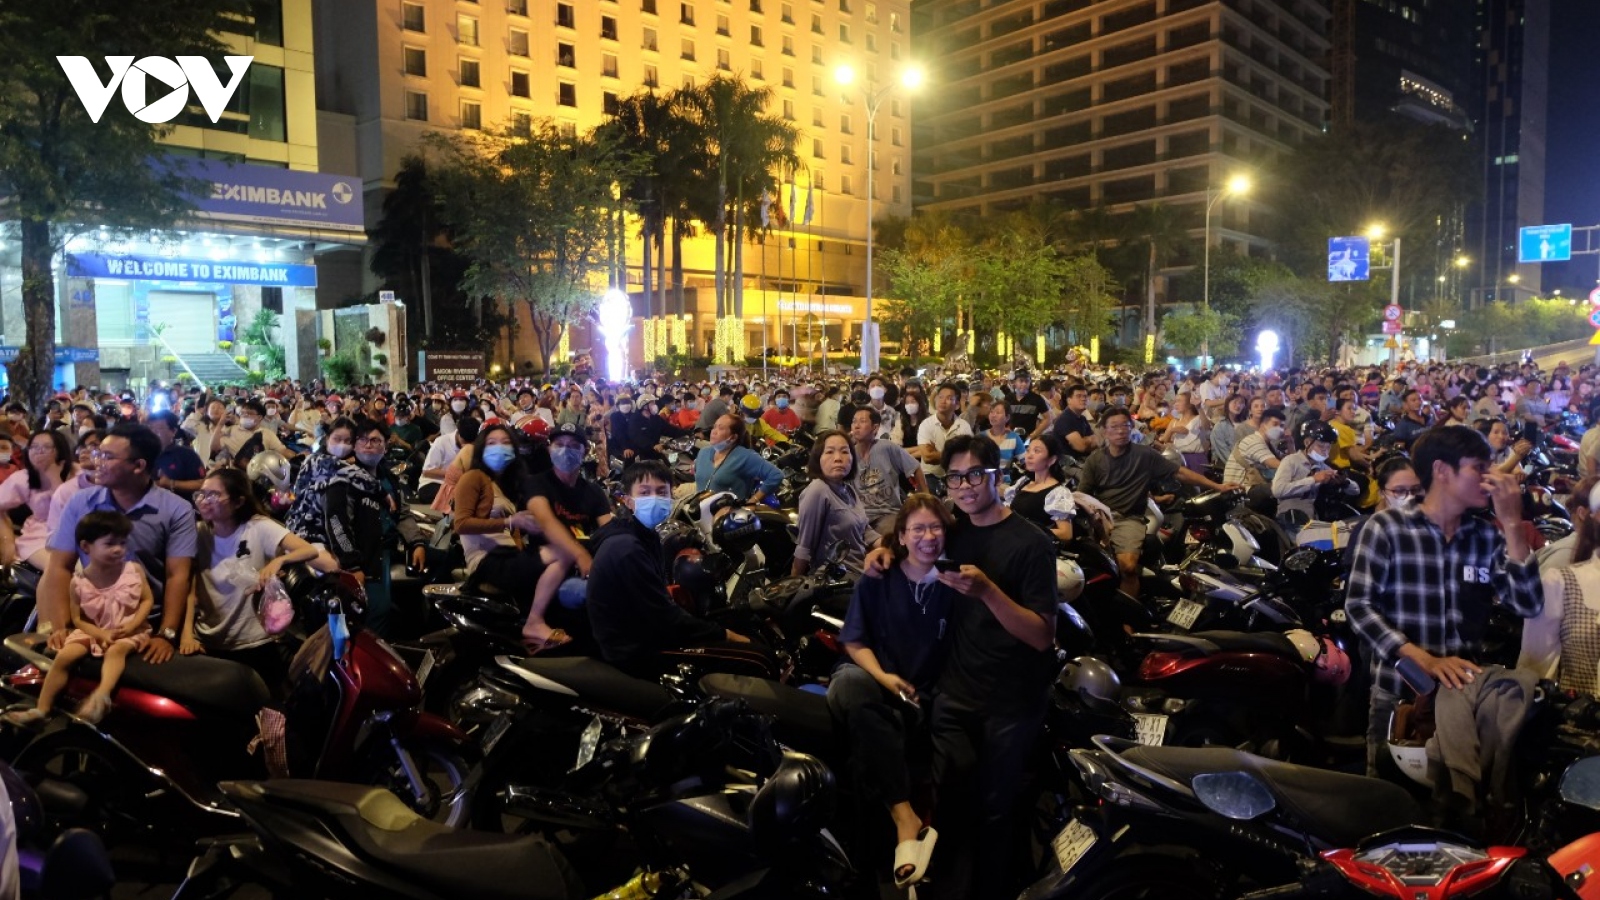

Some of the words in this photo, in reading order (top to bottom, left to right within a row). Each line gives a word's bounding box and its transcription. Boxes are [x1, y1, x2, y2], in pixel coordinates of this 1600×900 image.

[210, 182, 326, 209] EXIMBANK
[107, 259, 188, 278] WELCOME
[191, 264, 209, 279] TO
[213, 265, 288, 282] EXIMBANK
